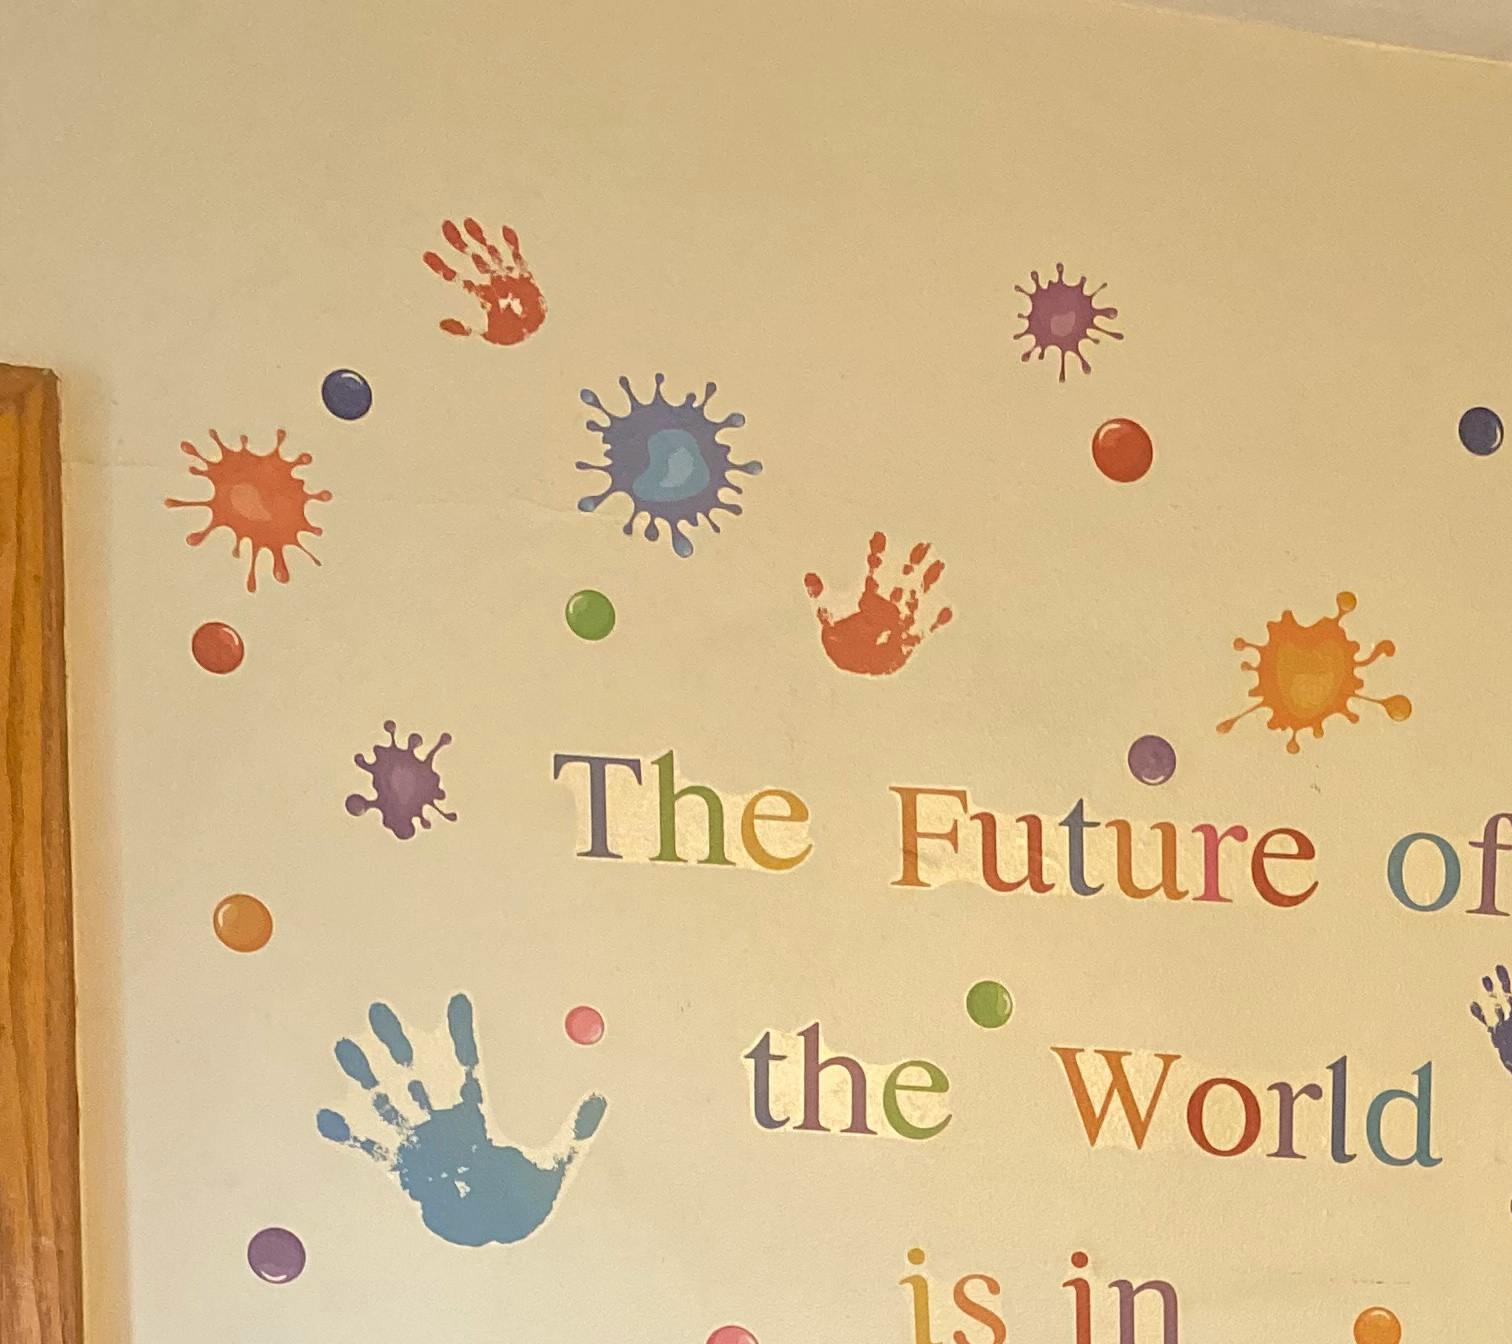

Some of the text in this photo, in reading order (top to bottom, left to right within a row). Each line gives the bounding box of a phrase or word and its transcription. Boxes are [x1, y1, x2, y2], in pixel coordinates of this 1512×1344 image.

[554, 750, 812, 870] The
[889, 785, 1319, 907] Future
[742, 1022, 1442, 1168] the World
